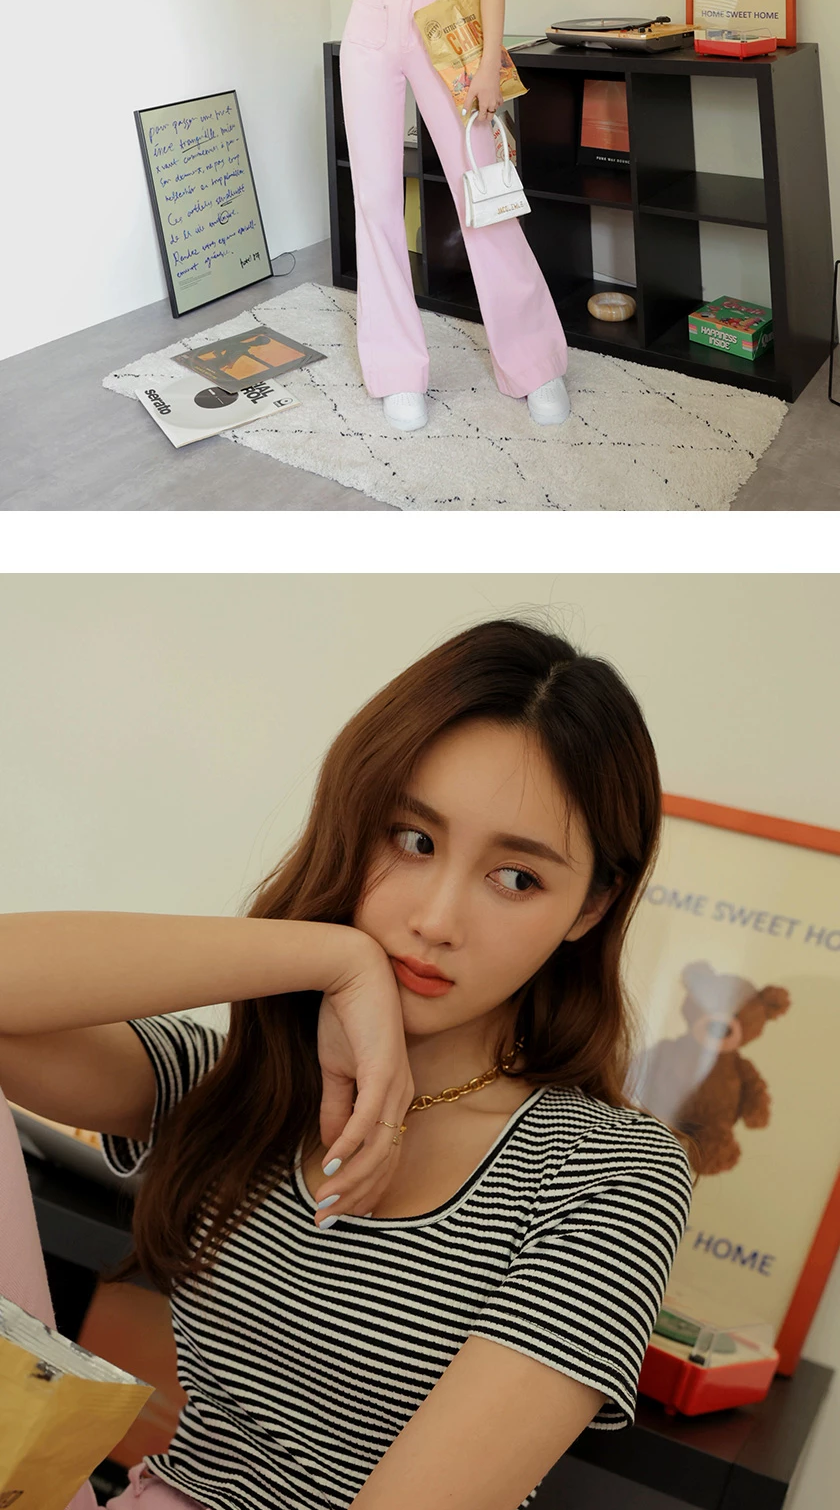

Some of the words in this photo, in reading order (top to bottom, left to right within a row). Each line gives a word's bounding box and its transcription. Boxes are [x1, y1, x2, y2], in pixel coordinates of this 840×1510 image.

[701, 10, 724, 18] HOME
[726, 10, 751, 19] SWEET
[753, 11, 779, 20] HOME
[701, 325, 738, 344] HAPPINESS
[144, 388, 172, 416] serato
[648, 884, 707, 917] OME
[711, 899, 802, 940] SWEET
[693, 1231, 776, 1277] HOME
